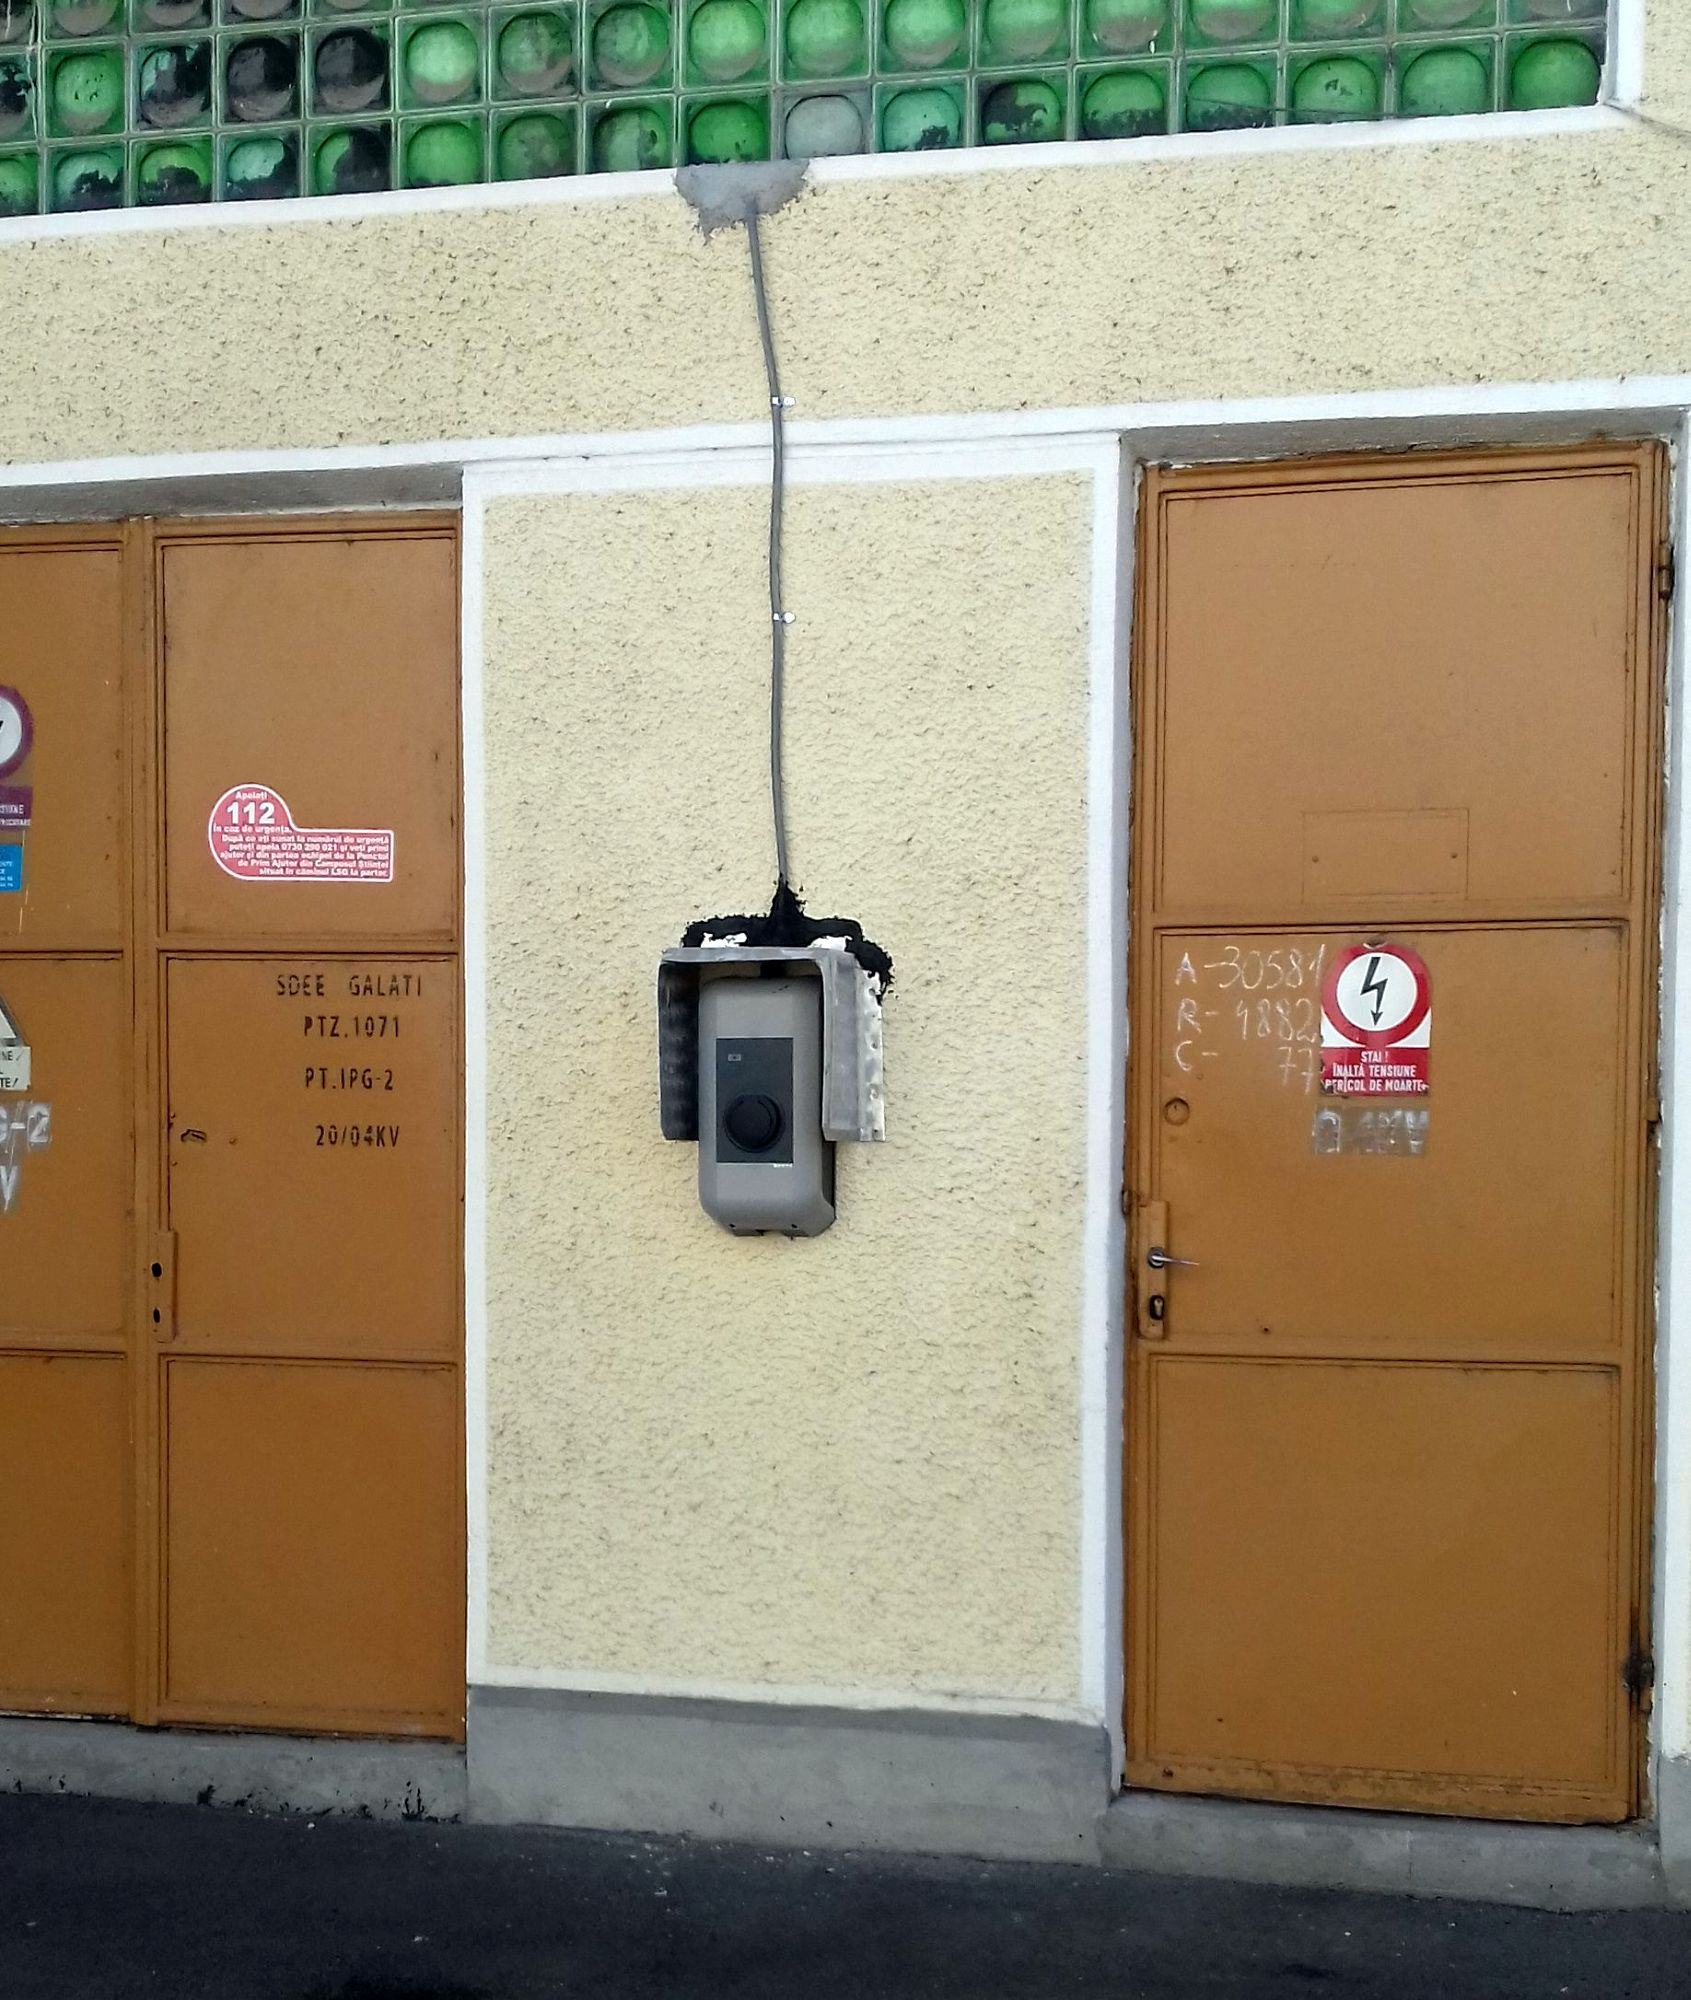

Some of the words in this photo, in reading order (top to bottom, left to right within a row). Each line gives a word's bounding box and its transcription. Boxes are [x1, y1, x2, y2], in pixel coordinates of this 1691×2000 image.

[227, 801, 275, 824] 112
[241, 824, 253, 832] de
[237, 859, 249, 867] de
[250, 859, 270, 867] Prim
[271, 859, 298, 868] Ajutor
[276, 974, 325, 997] SDEE
[349, 974, 421, 997] GALATI
[304, 1015, 399, 1038] PTZ.1071
[1277, 1046, 1314, 1095] 77
[1369, 1064, 1417, 1077] TENSIUNE
[1325, 1078, 1367, 1092] PERICOL
[1369, 1079, 1383, 1091] DE
[1385, 1079, 1424, 1092] MOARTE
